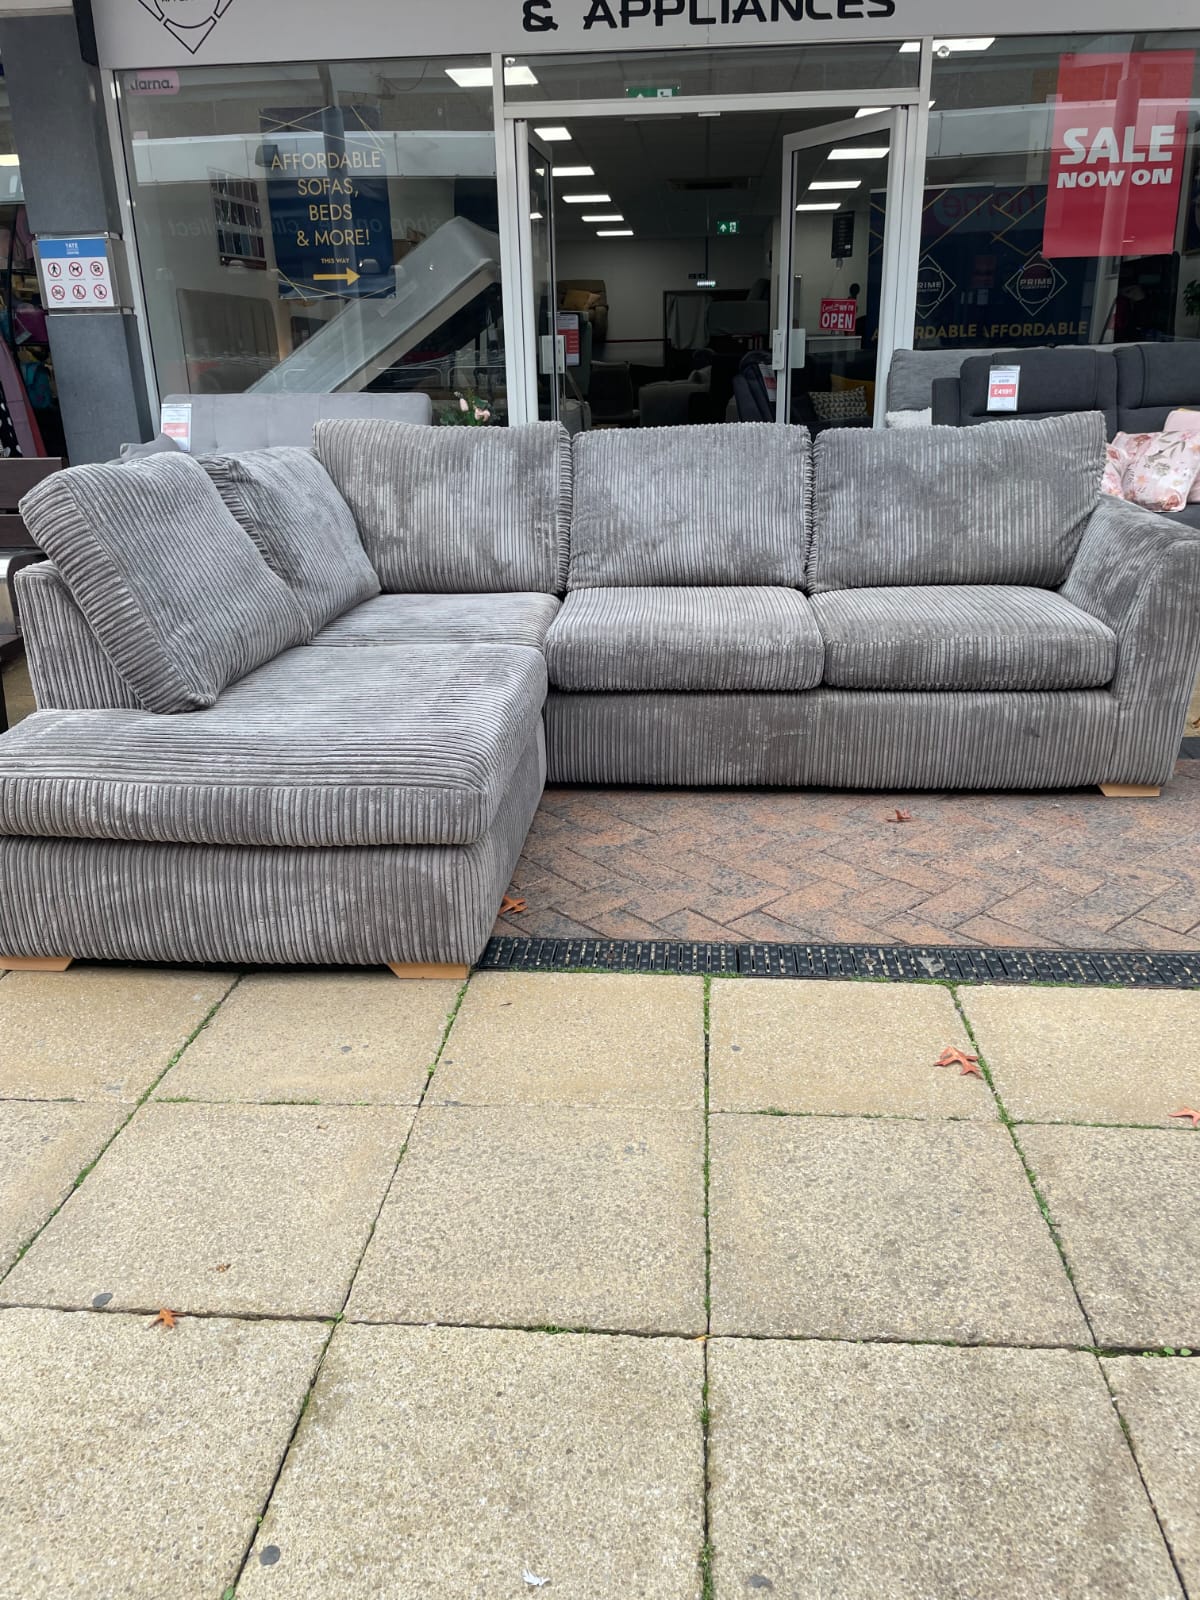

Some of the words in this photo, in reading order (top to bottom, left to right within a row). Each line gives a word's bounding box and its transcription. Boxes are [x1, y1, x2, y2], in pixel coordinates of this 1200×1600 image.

[523, 0, 558, 32] &
[582, 0, 896, 30] APPLIANCES
[1059, 125, 1176, 165] SALE
[271, 151, 382, 171] AFFORDABLE
[1056, 170, 1125, 188] NOW
[1131, 168, 1173, 186] ON
[297, 178, 359, 198] SOFAS,
[308, 203, 353, 221] BEDS
[296, 230, 310, 246] &
[315, 229, 371, 247] MORE!
[917, 281, 942, 289] RIME
[1019, 277, 1053, 286] PRIME
[821, 312, 853, 329] OPEN
